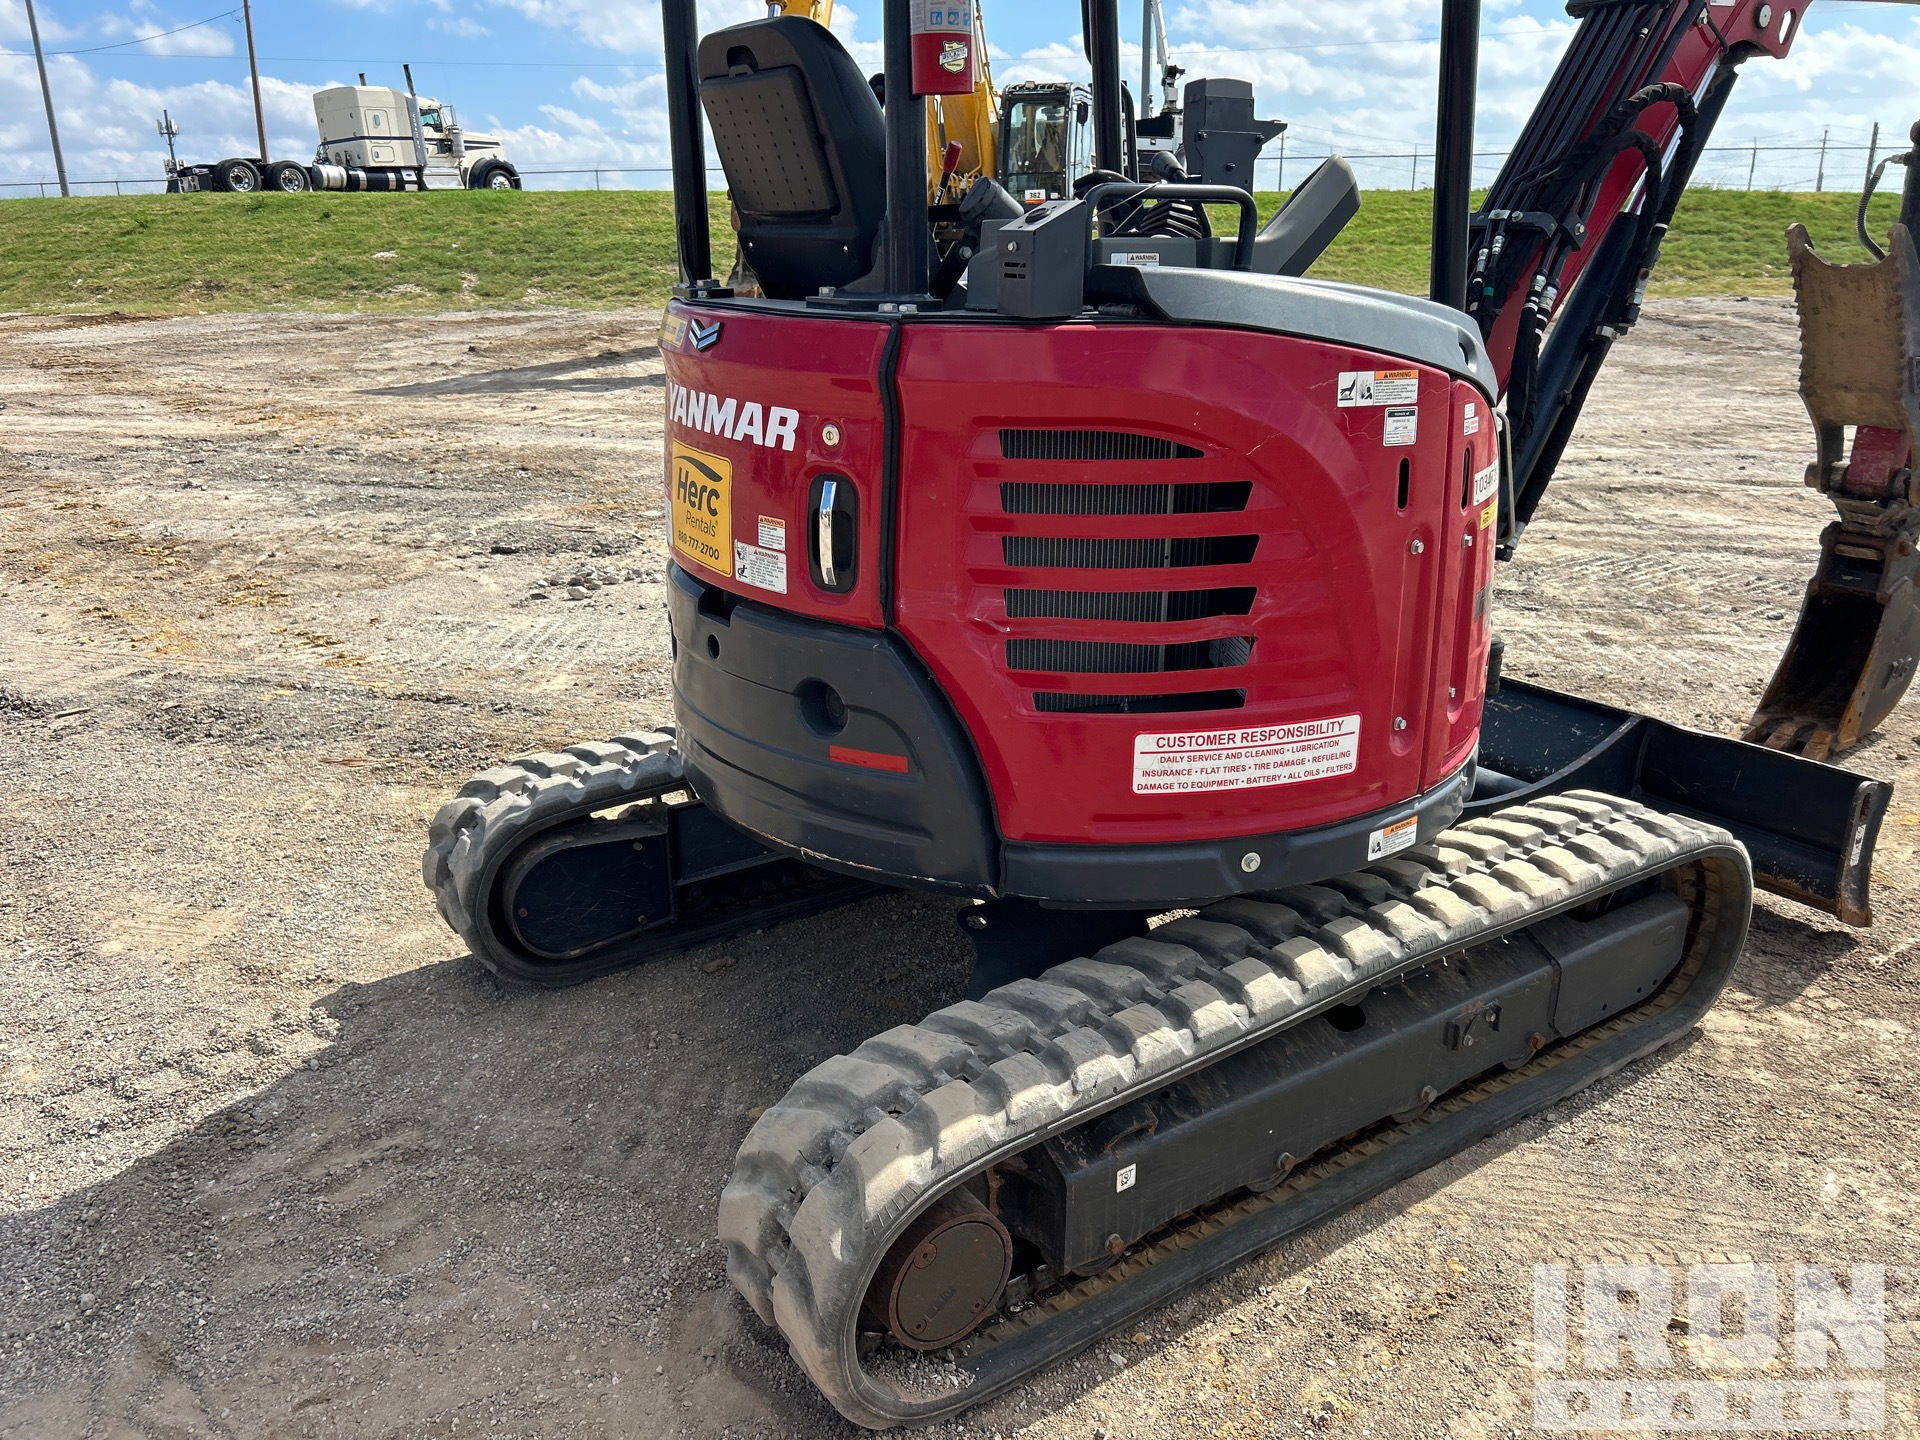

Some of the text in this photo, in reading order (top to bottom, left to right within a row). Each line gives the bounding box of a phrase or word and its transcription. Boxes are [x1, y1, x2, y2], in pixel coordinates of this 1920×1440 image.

[669, 382, 799, 452] YANMAR
[677, 467, 720, 517] Herc
[764, 517, 783, 526] WARNING
[678, 530, 719, 560] 888-777-2700
[1156, 720, 1345, 749] CUSTOMER RESPONSIBILITY
[1142, 750, 1350, 777] INSURANCE FLAT TIRES TIRE DAMAGE REFUELING
[1160, 740, 1339, 764] DAILY SERVICE AND CLEANING LUBRICATION
[1137, 763, 1353, 791] DAMAGE TO EQUIPMENT BATTERY ALL OILS FILTERS
